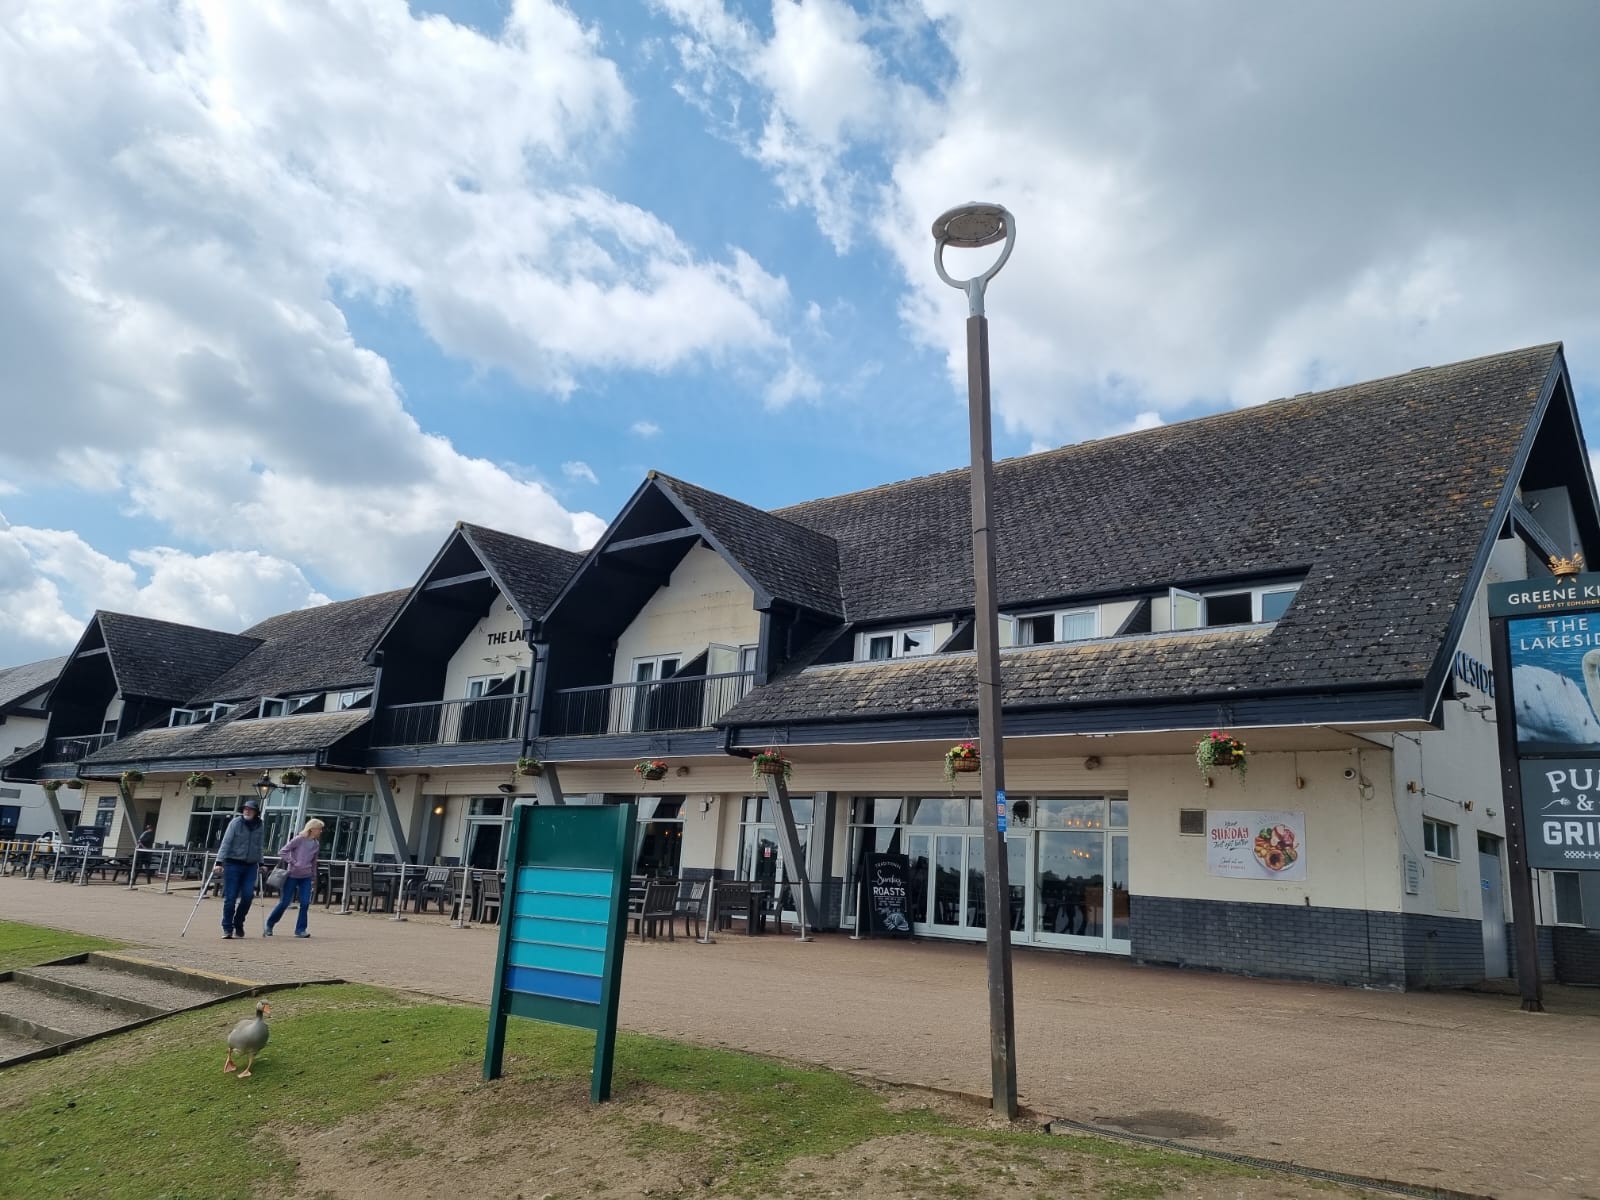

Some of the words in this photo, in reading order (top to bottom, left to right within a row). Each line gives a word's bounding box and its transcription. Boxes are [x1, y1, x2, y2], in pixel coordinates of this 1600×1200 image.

[1508, 587, 1577, 605] GREENE
[1567, 599, 1600, 607] EDMUNDS
[1547, 618, 1589, 633] THE
[488, 632, 507, 645] THE
[1545, 768, 1600, 793] PU
[1577, 793, 1595, 811] &
[1211, 827, 1249, 840] SUNDAY
[1543, 821, 1600, 846] GRI
[877, 869, 902, 887] Sunday
[873, 887, 906, 896] ROASTS
